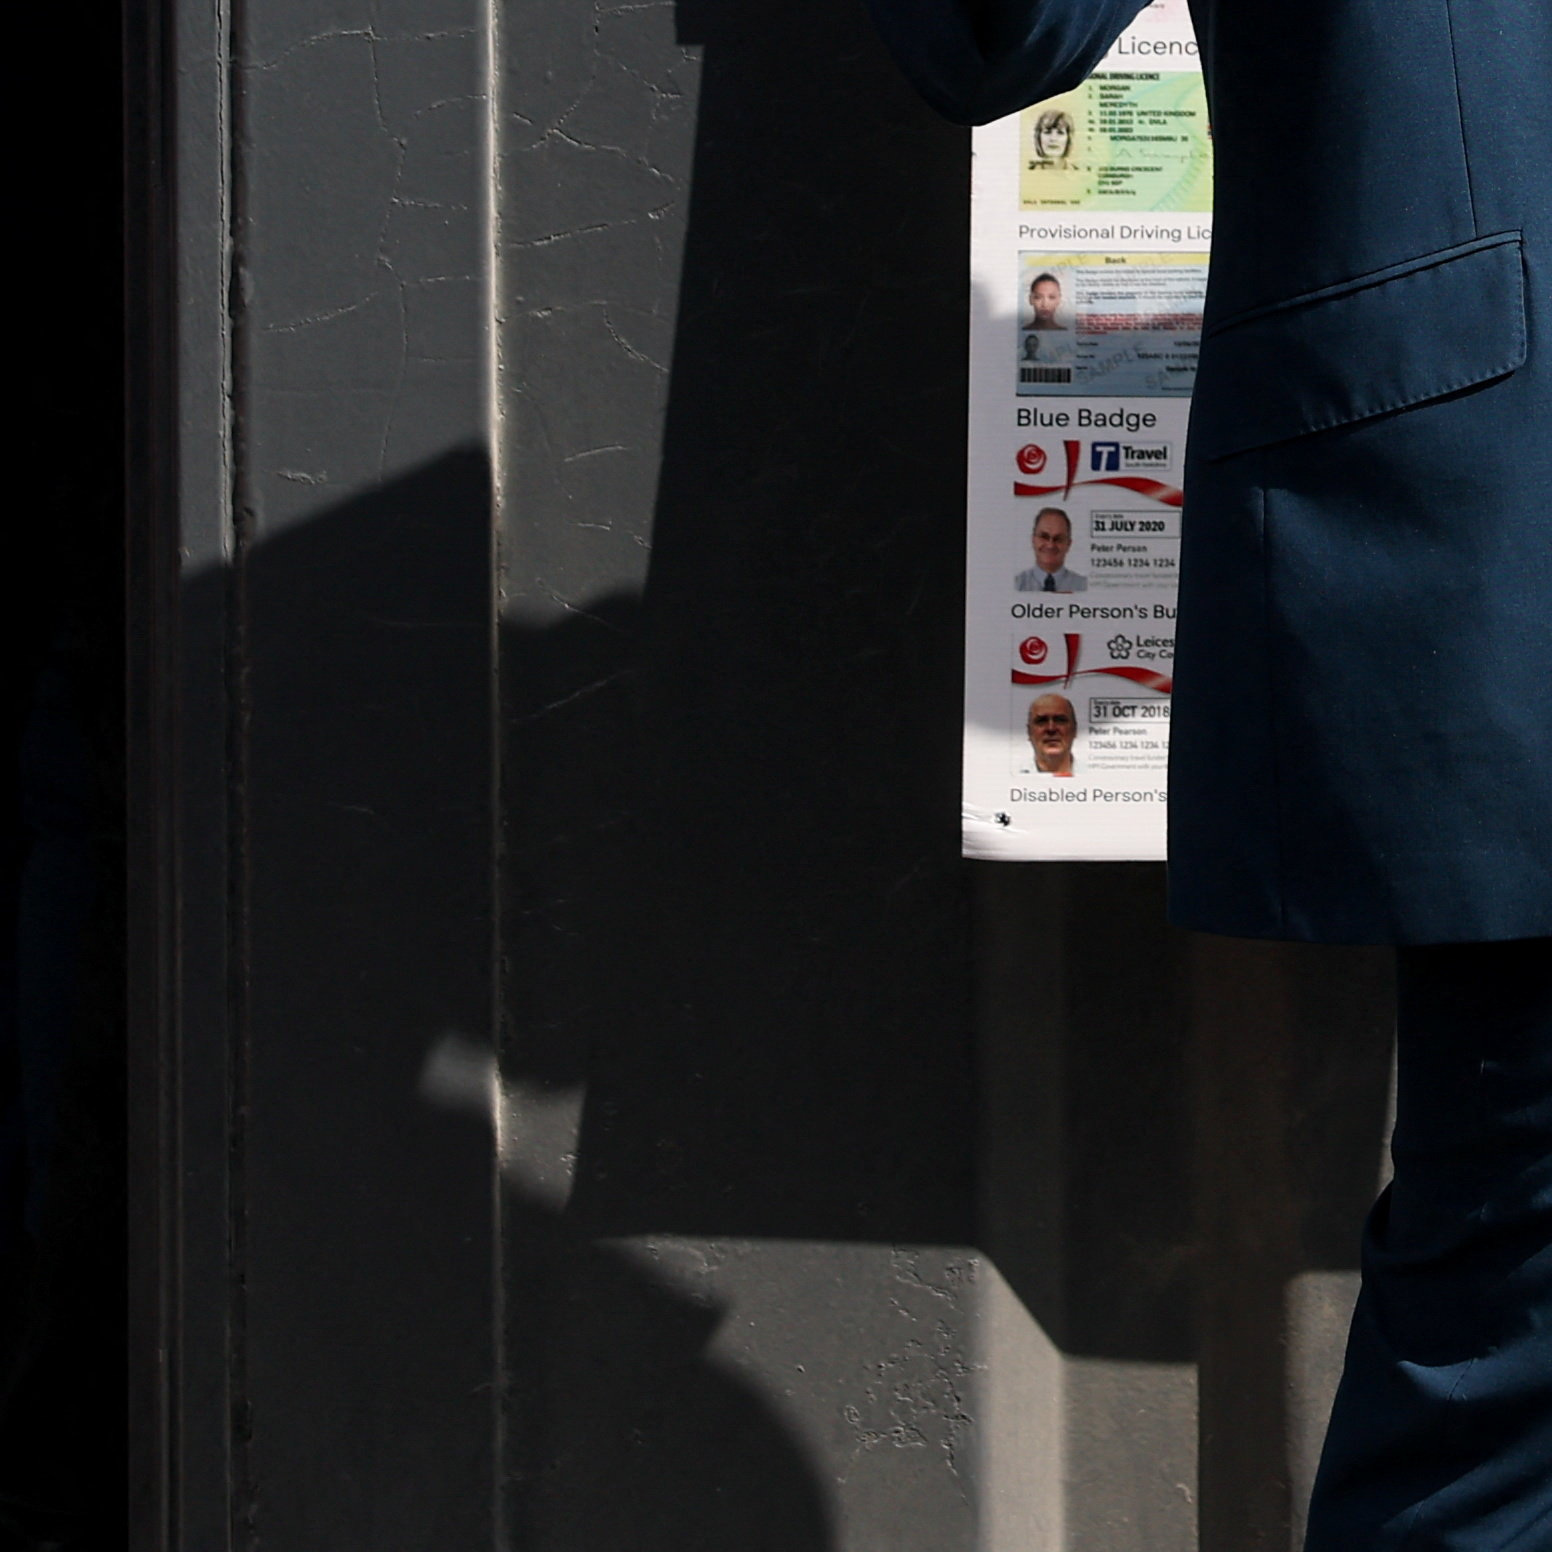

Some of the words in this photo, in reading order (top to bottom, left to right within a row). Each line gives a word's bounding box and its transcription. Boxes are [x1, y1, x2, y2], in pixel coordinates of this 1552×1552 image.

[1018, 225, 1114, 239] Provisional
[1120, 225, 1182, 243] Driving
[1016, 407, 1070, 427] Blue
[1077, 407, 1157, 432] Badge
[1122, 445, 1168, 460] Travel
[1094, 520, 1106, 532] 31
[1110, 520, 1136, 532] JULY
[1138, 520, 1165, 532] 2020
[1090, 543, 1114, 553] Peter
[1117, 543, 1148, 553] Person
[1091, 558, 1124, 568] 123456
[1128, 558, 1150, 568] 1234
[1153, 558, 1176, 568] 1234
[1011, 603, 1064, 619] Older
[1069, 603, 1148, 619] Person's
[1136, 649, 1156, 660] City
[1094, 706, 1108, 718] 31
[1112, 705, 1138, 718] OCT
[1141, 706, 1170, 718] 2018
[1088, 727, 1111, 736] Peter
[1089, 741, 1117, 749] 123456
[1120, 741, 1138, 749] 1234
[1141, 741, 1159, 749] 1234
[1010, 788, 1087, 802] Disabled
[1093, 788, 1168, 802] Person's
